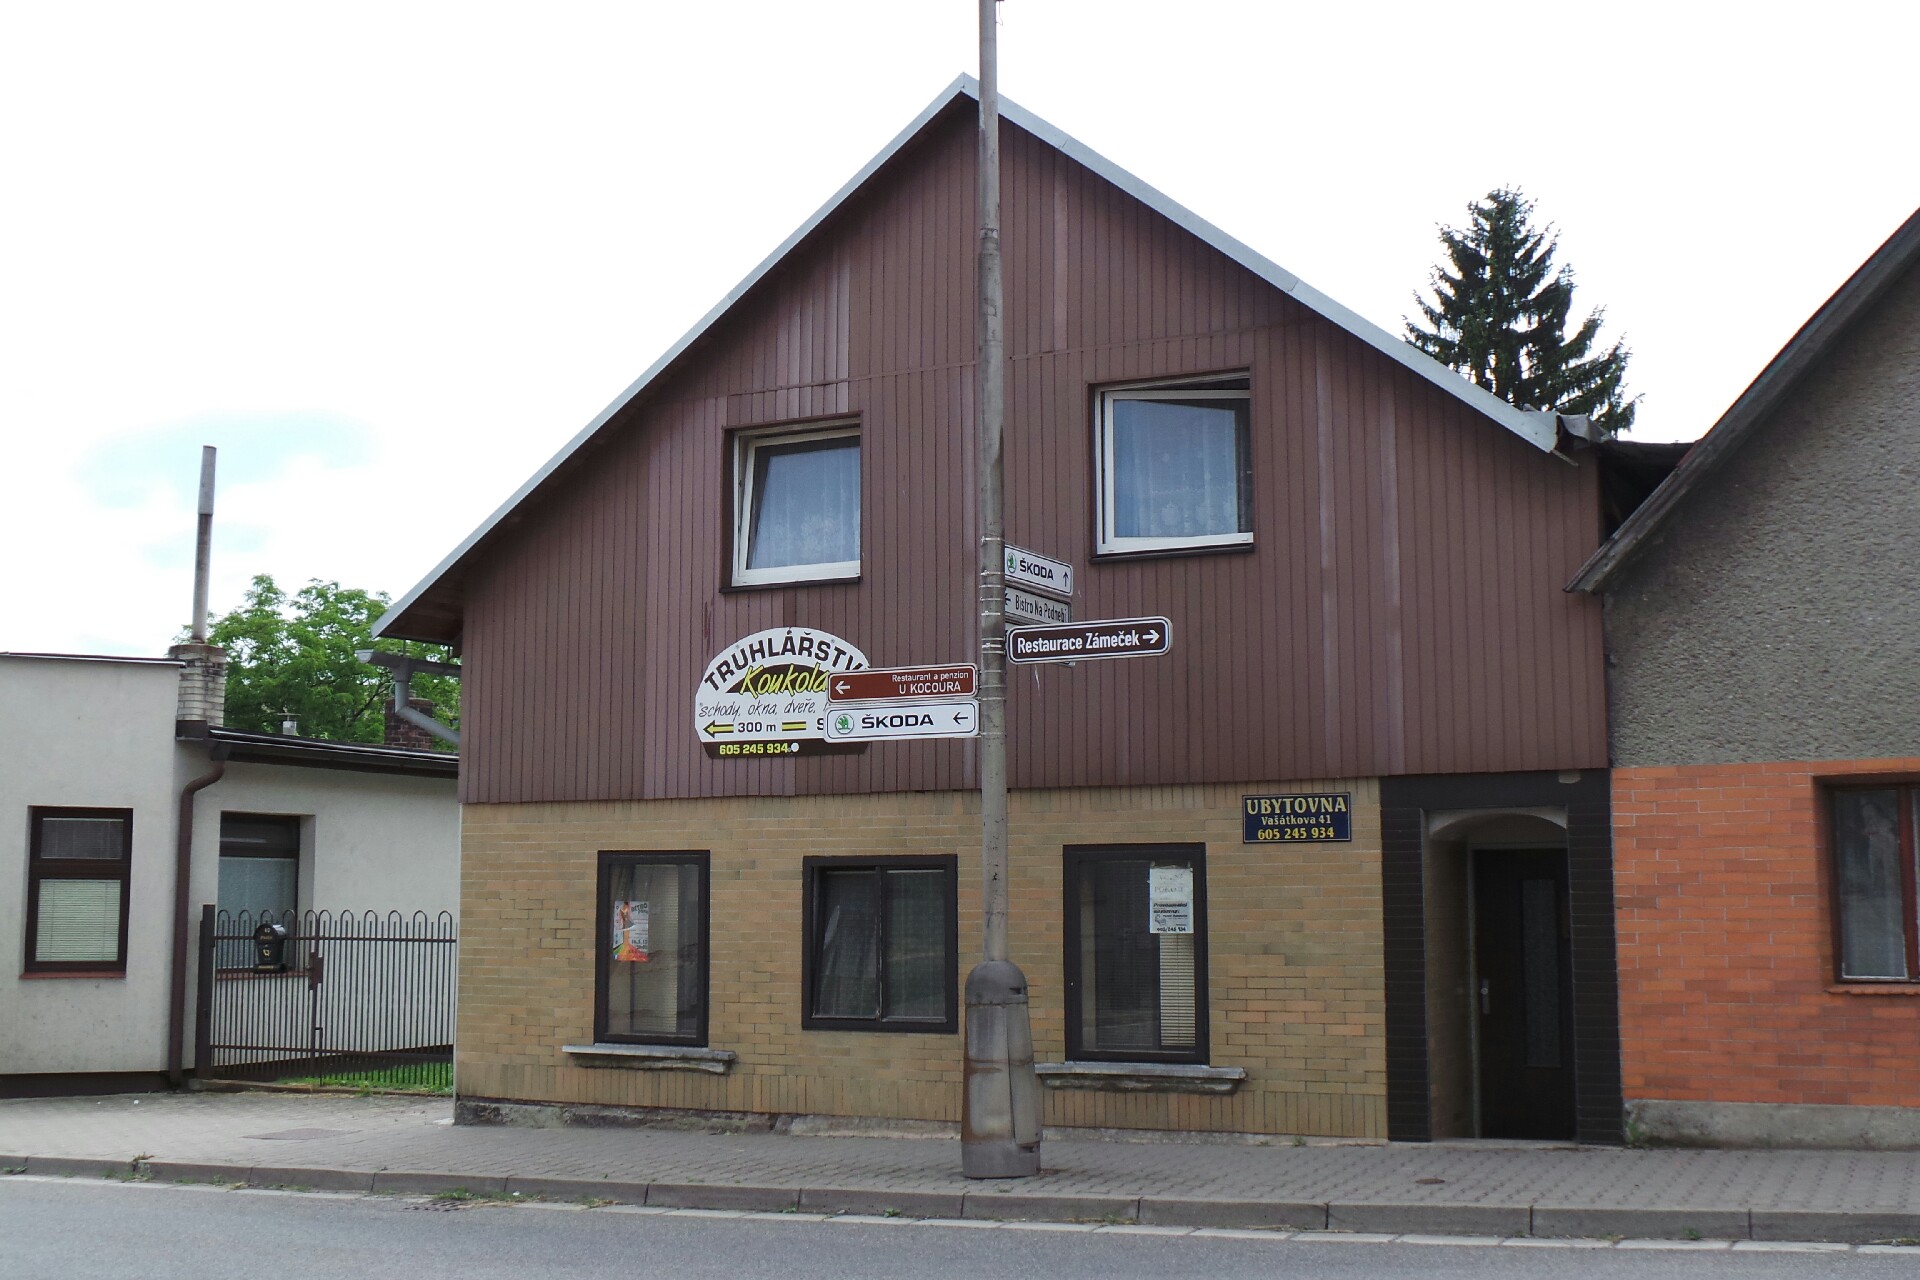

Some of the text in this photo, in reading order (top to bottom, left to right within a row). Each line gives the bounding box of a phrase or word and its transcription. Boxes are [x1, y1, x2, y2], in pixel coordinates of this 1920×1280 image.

[1019, 557, 1054, 581] ŠKODA
[1015, 594, 1033, 614] Bistro
[1034, 600, 1043, 617] Na
[1017, 630, 1141, 654] Restaurace Zámeček
[704, 630, 870, 691] TRUHLÁŘSTV
[891, 672, 931, 682] Restaurant
[940, 672, 969, 681] penzion
[899, 681, 961, 694] U KOCOURA
[737, 722, 763, 733] 300
[766, 724, 777, 732] m
[861, 713, 935, 729] ŠKODA
[719, 743, 788, 755] 605 245 934
[1246, 797, 1347, 815] UBYTOVNA
[1261, 814, 1332, 826] Vašátkova 41
[1257, 827, 1335, 840] 605 245 934
